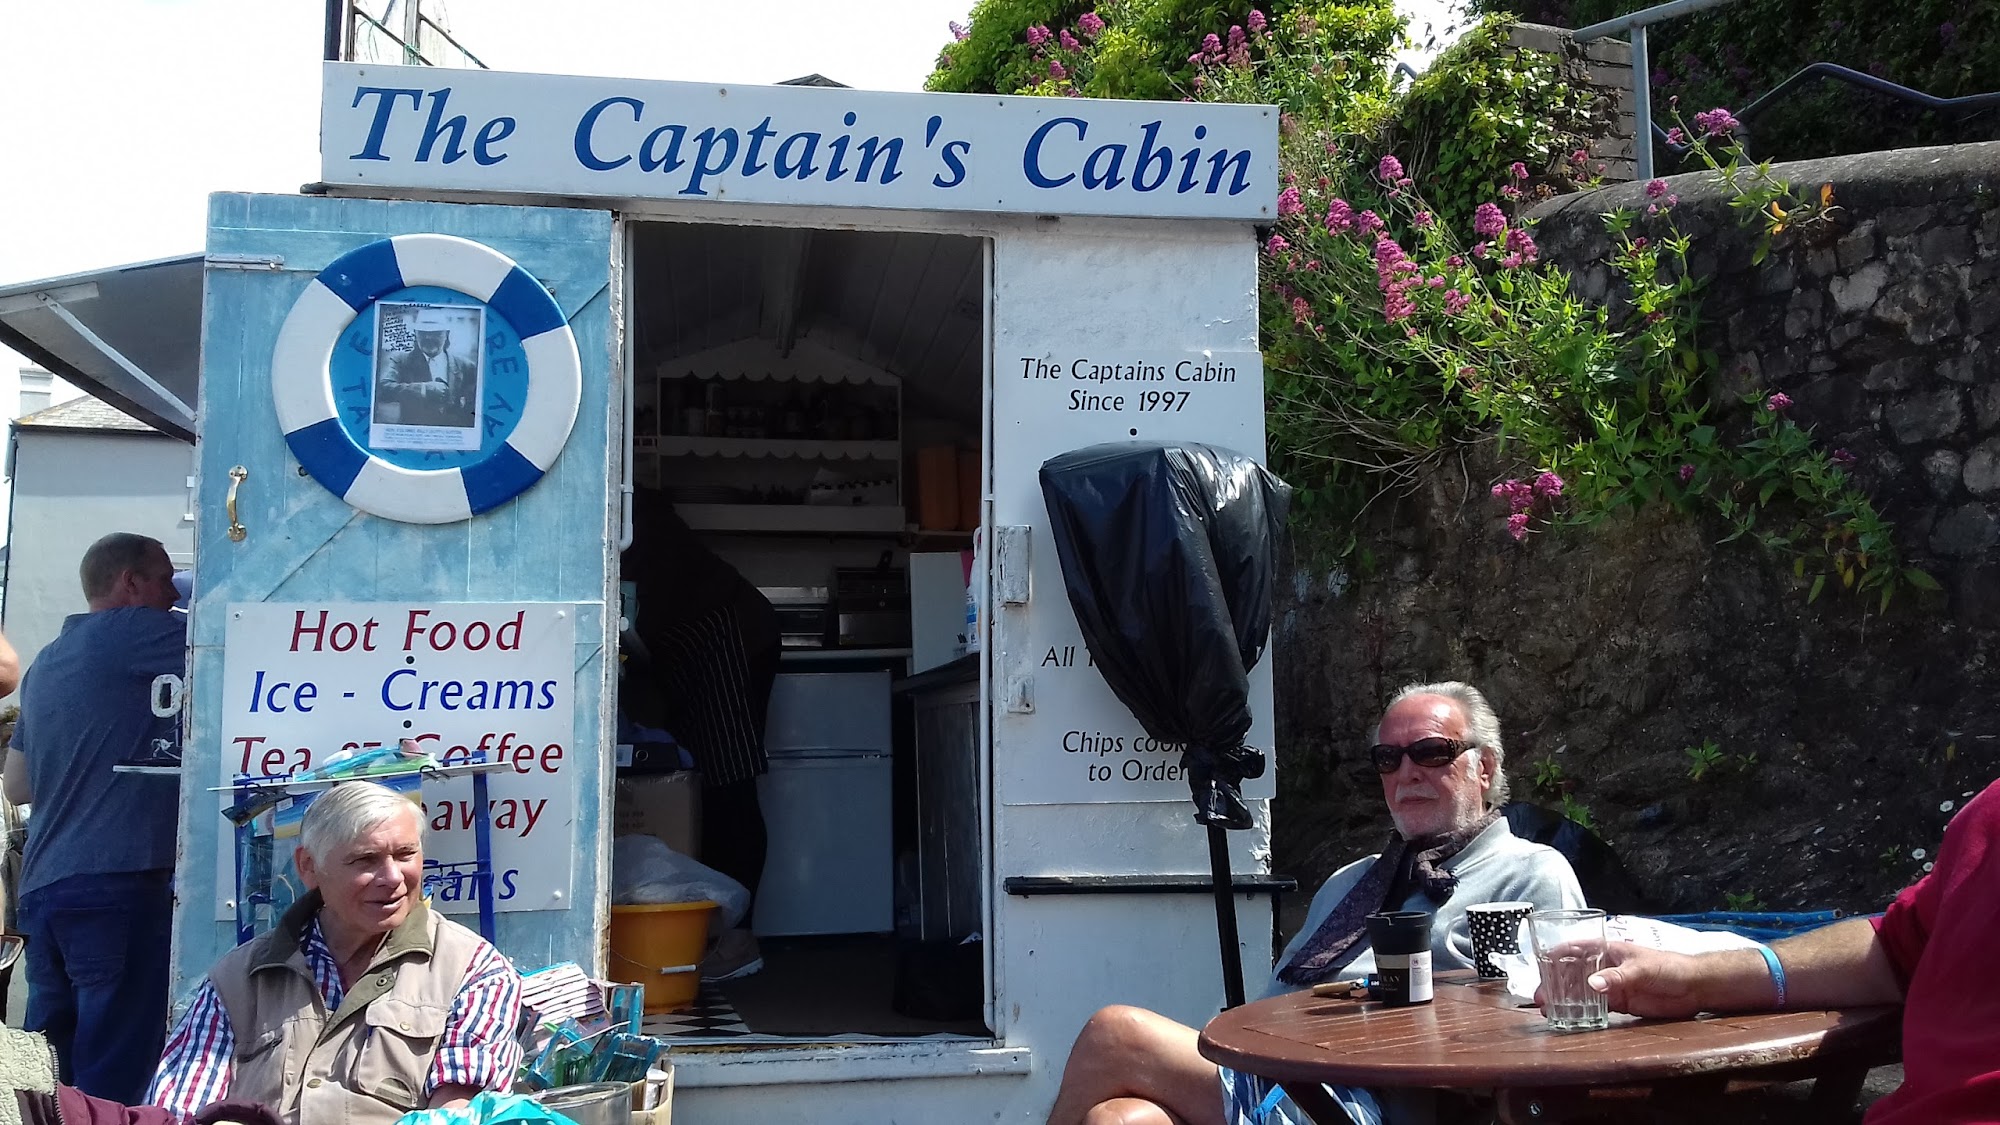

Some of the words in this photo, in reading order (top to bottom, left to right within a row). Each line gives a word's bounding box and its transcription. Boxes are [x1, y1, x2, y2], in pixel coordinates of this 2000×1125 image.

[350, 86, 516, 166] The
[574, 96, 971, 196] Captain's
[1023, 117, 1252, 196] Cabin
[1020, 357, 1061, 379] The
[1071, 359, 1166, 384] Captains
[1175, 360, 1236, 382] Cabin
[1068, 389, 1124, 411] Since
[1139, 390, 1191, 412] 1997
[289, 610, 379, 652] Hot
[402, 610, 526, 651] Food
[1040, 645, 1075, 667] All
[248, 670, 318, 713] Ice
[381, 669, 557, 711] Creams
[232, 737, 312, 776] Tea
[1062, 730, 1124, 758] Chips
[1088, 763, 1112, 782] to
[1122, 759, 1189, 781] Order
